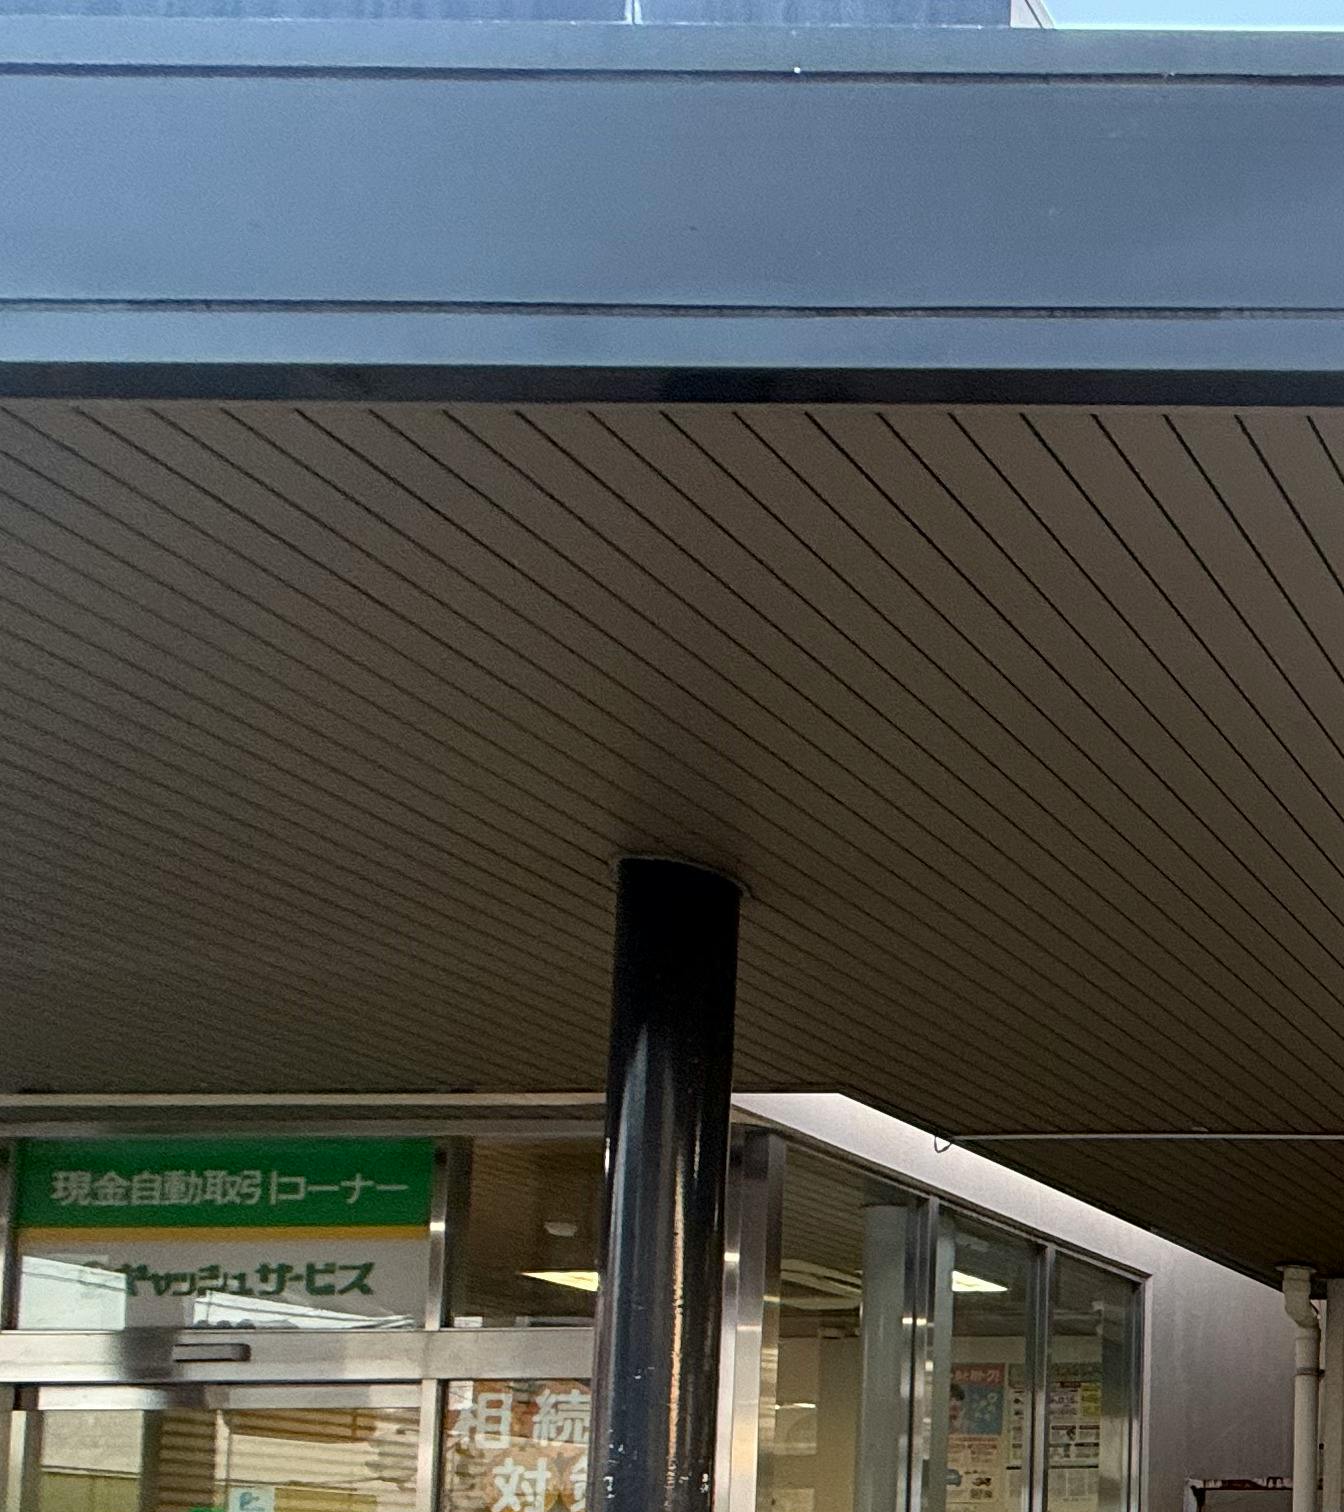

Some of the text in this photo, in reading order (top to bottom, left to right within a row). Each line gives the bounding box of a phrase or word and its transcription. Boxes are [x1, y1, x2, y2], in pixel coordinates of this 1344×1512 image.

[50, 1169, 410, 1206] 現金自動取引コーナー
